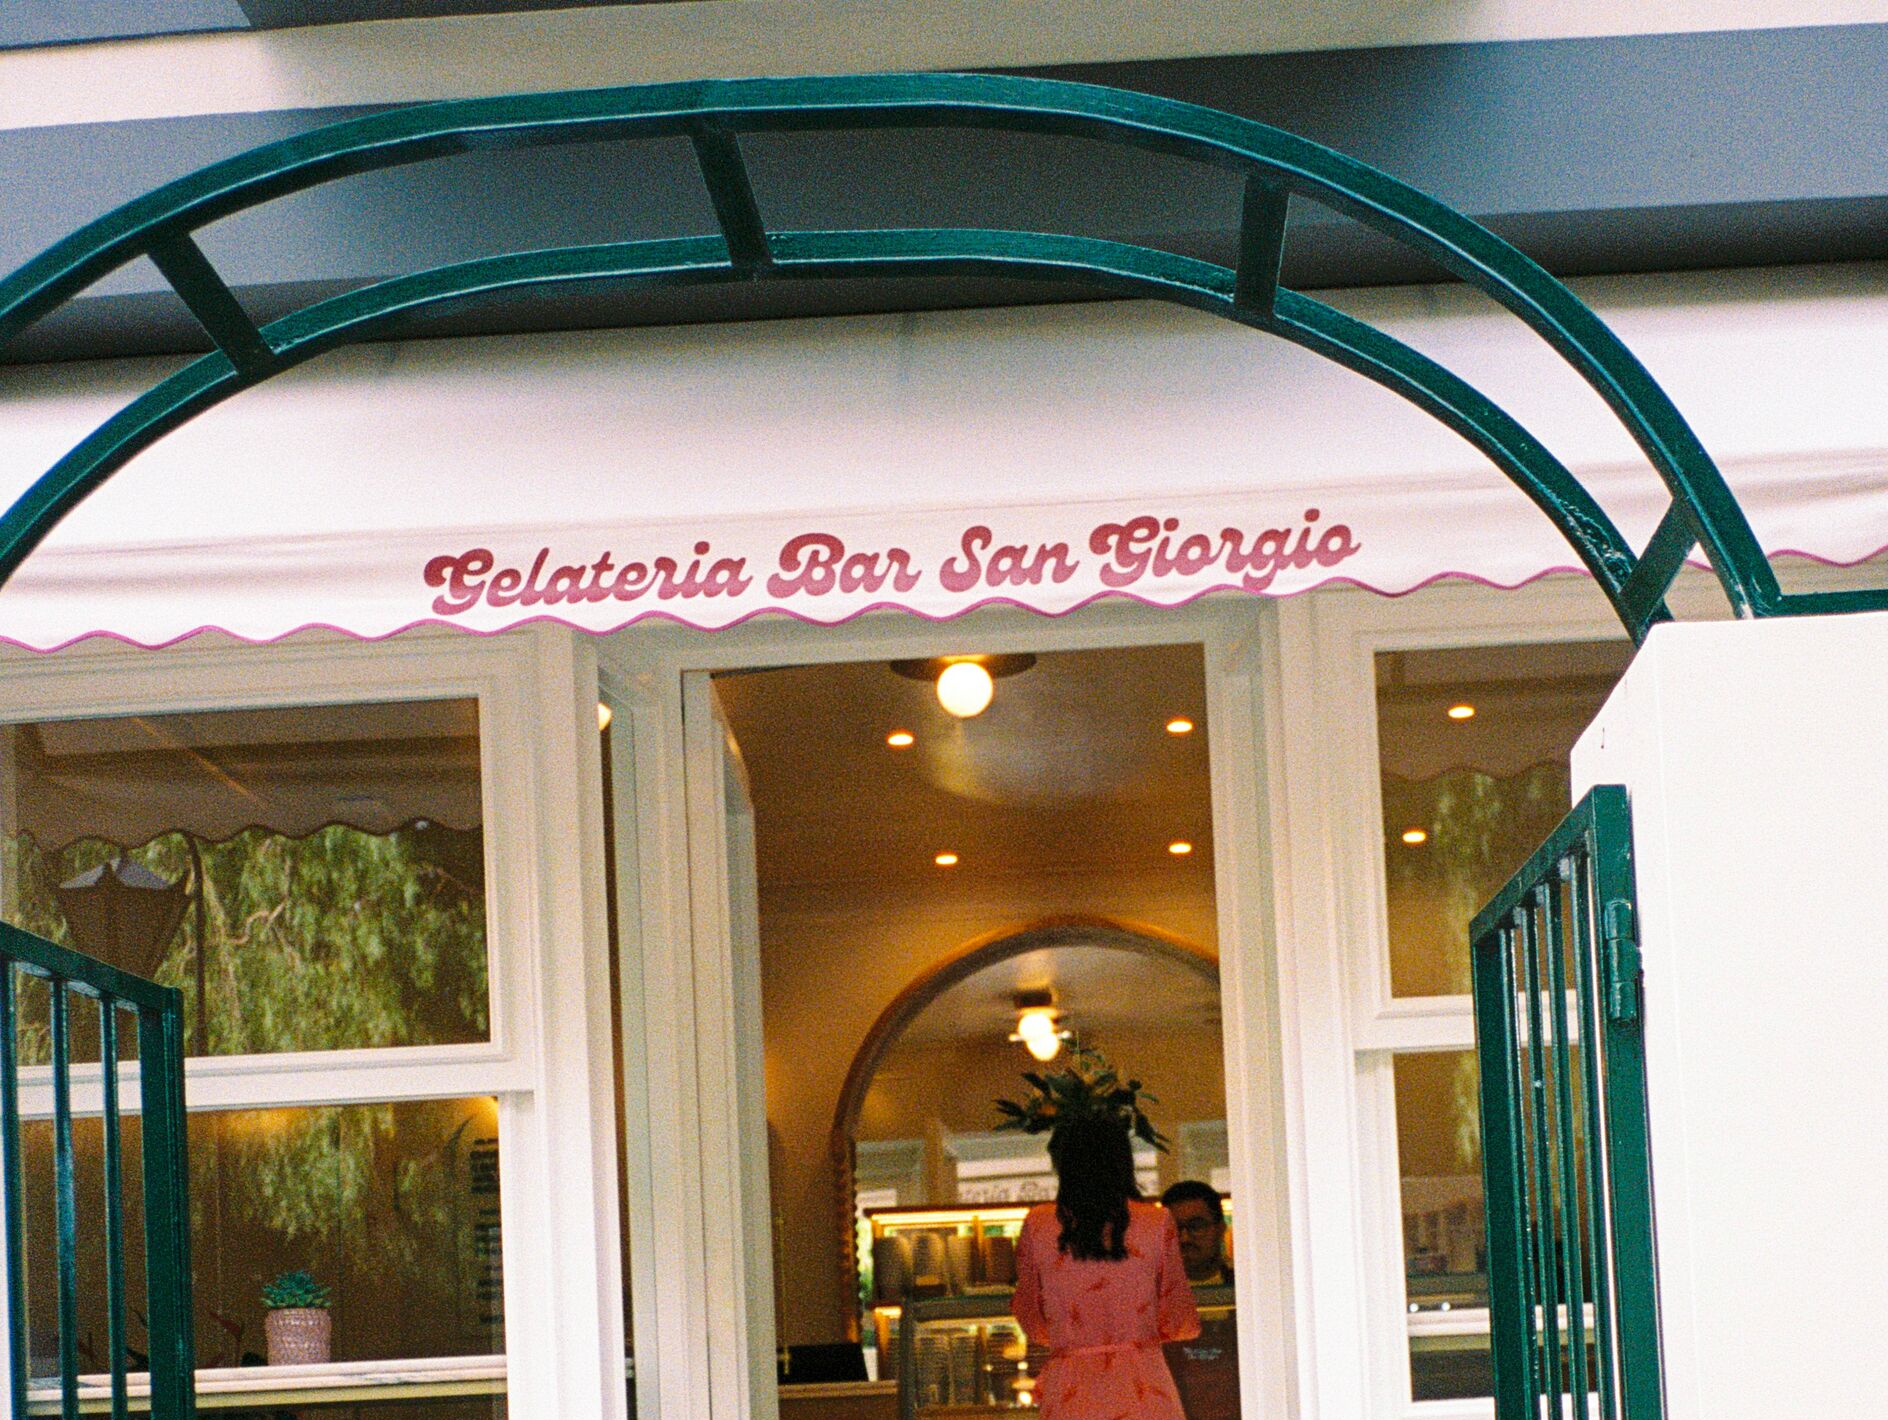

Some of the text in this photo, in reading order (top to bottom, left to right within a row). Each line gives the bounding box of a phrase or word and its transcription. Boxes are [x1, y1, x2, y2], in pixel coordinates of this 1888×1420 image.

[424, 508, 1360, 616] Gelateria Bar San Giorgio
